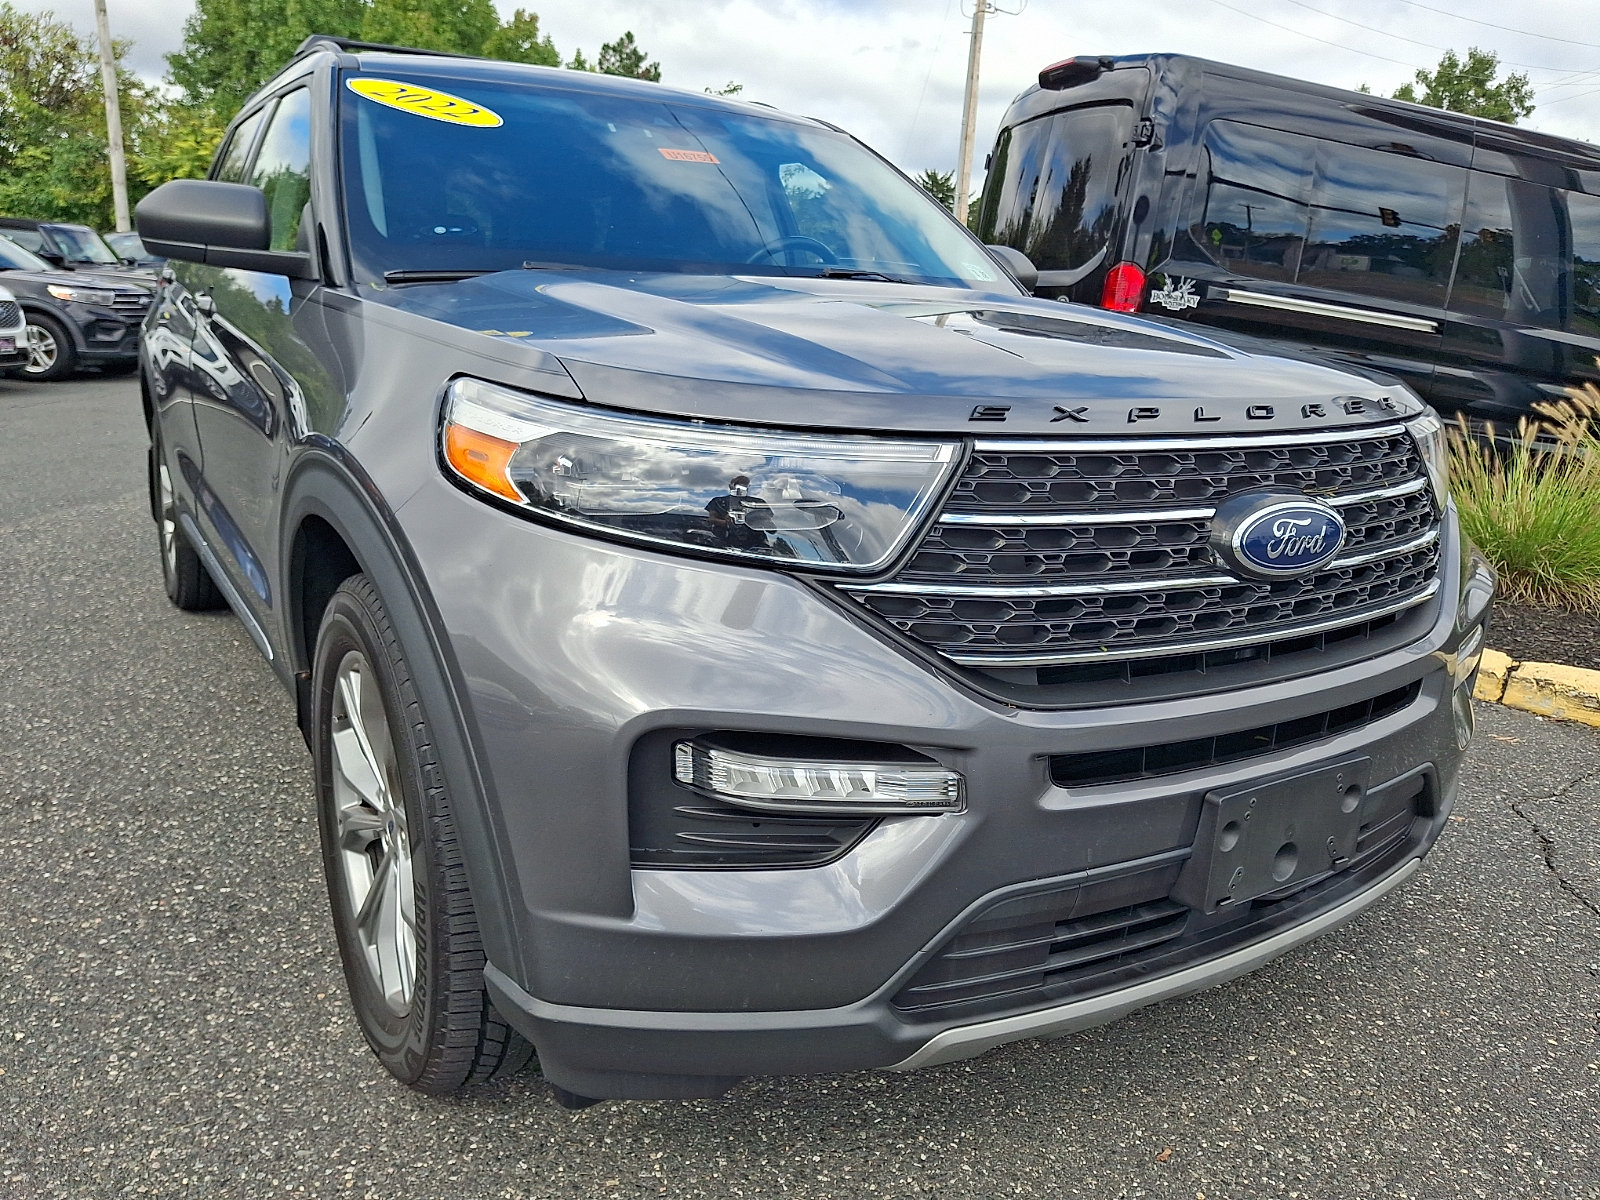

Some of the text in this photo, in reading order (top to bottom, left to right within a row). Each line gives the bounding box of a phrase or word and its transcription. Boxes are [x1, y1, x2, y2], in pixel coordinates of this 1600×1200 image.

[368, 87, 480, 118] 2022
[968, 396, 1397, 424] EXPLORER
[1266, 517, 1327, 560] Ford
